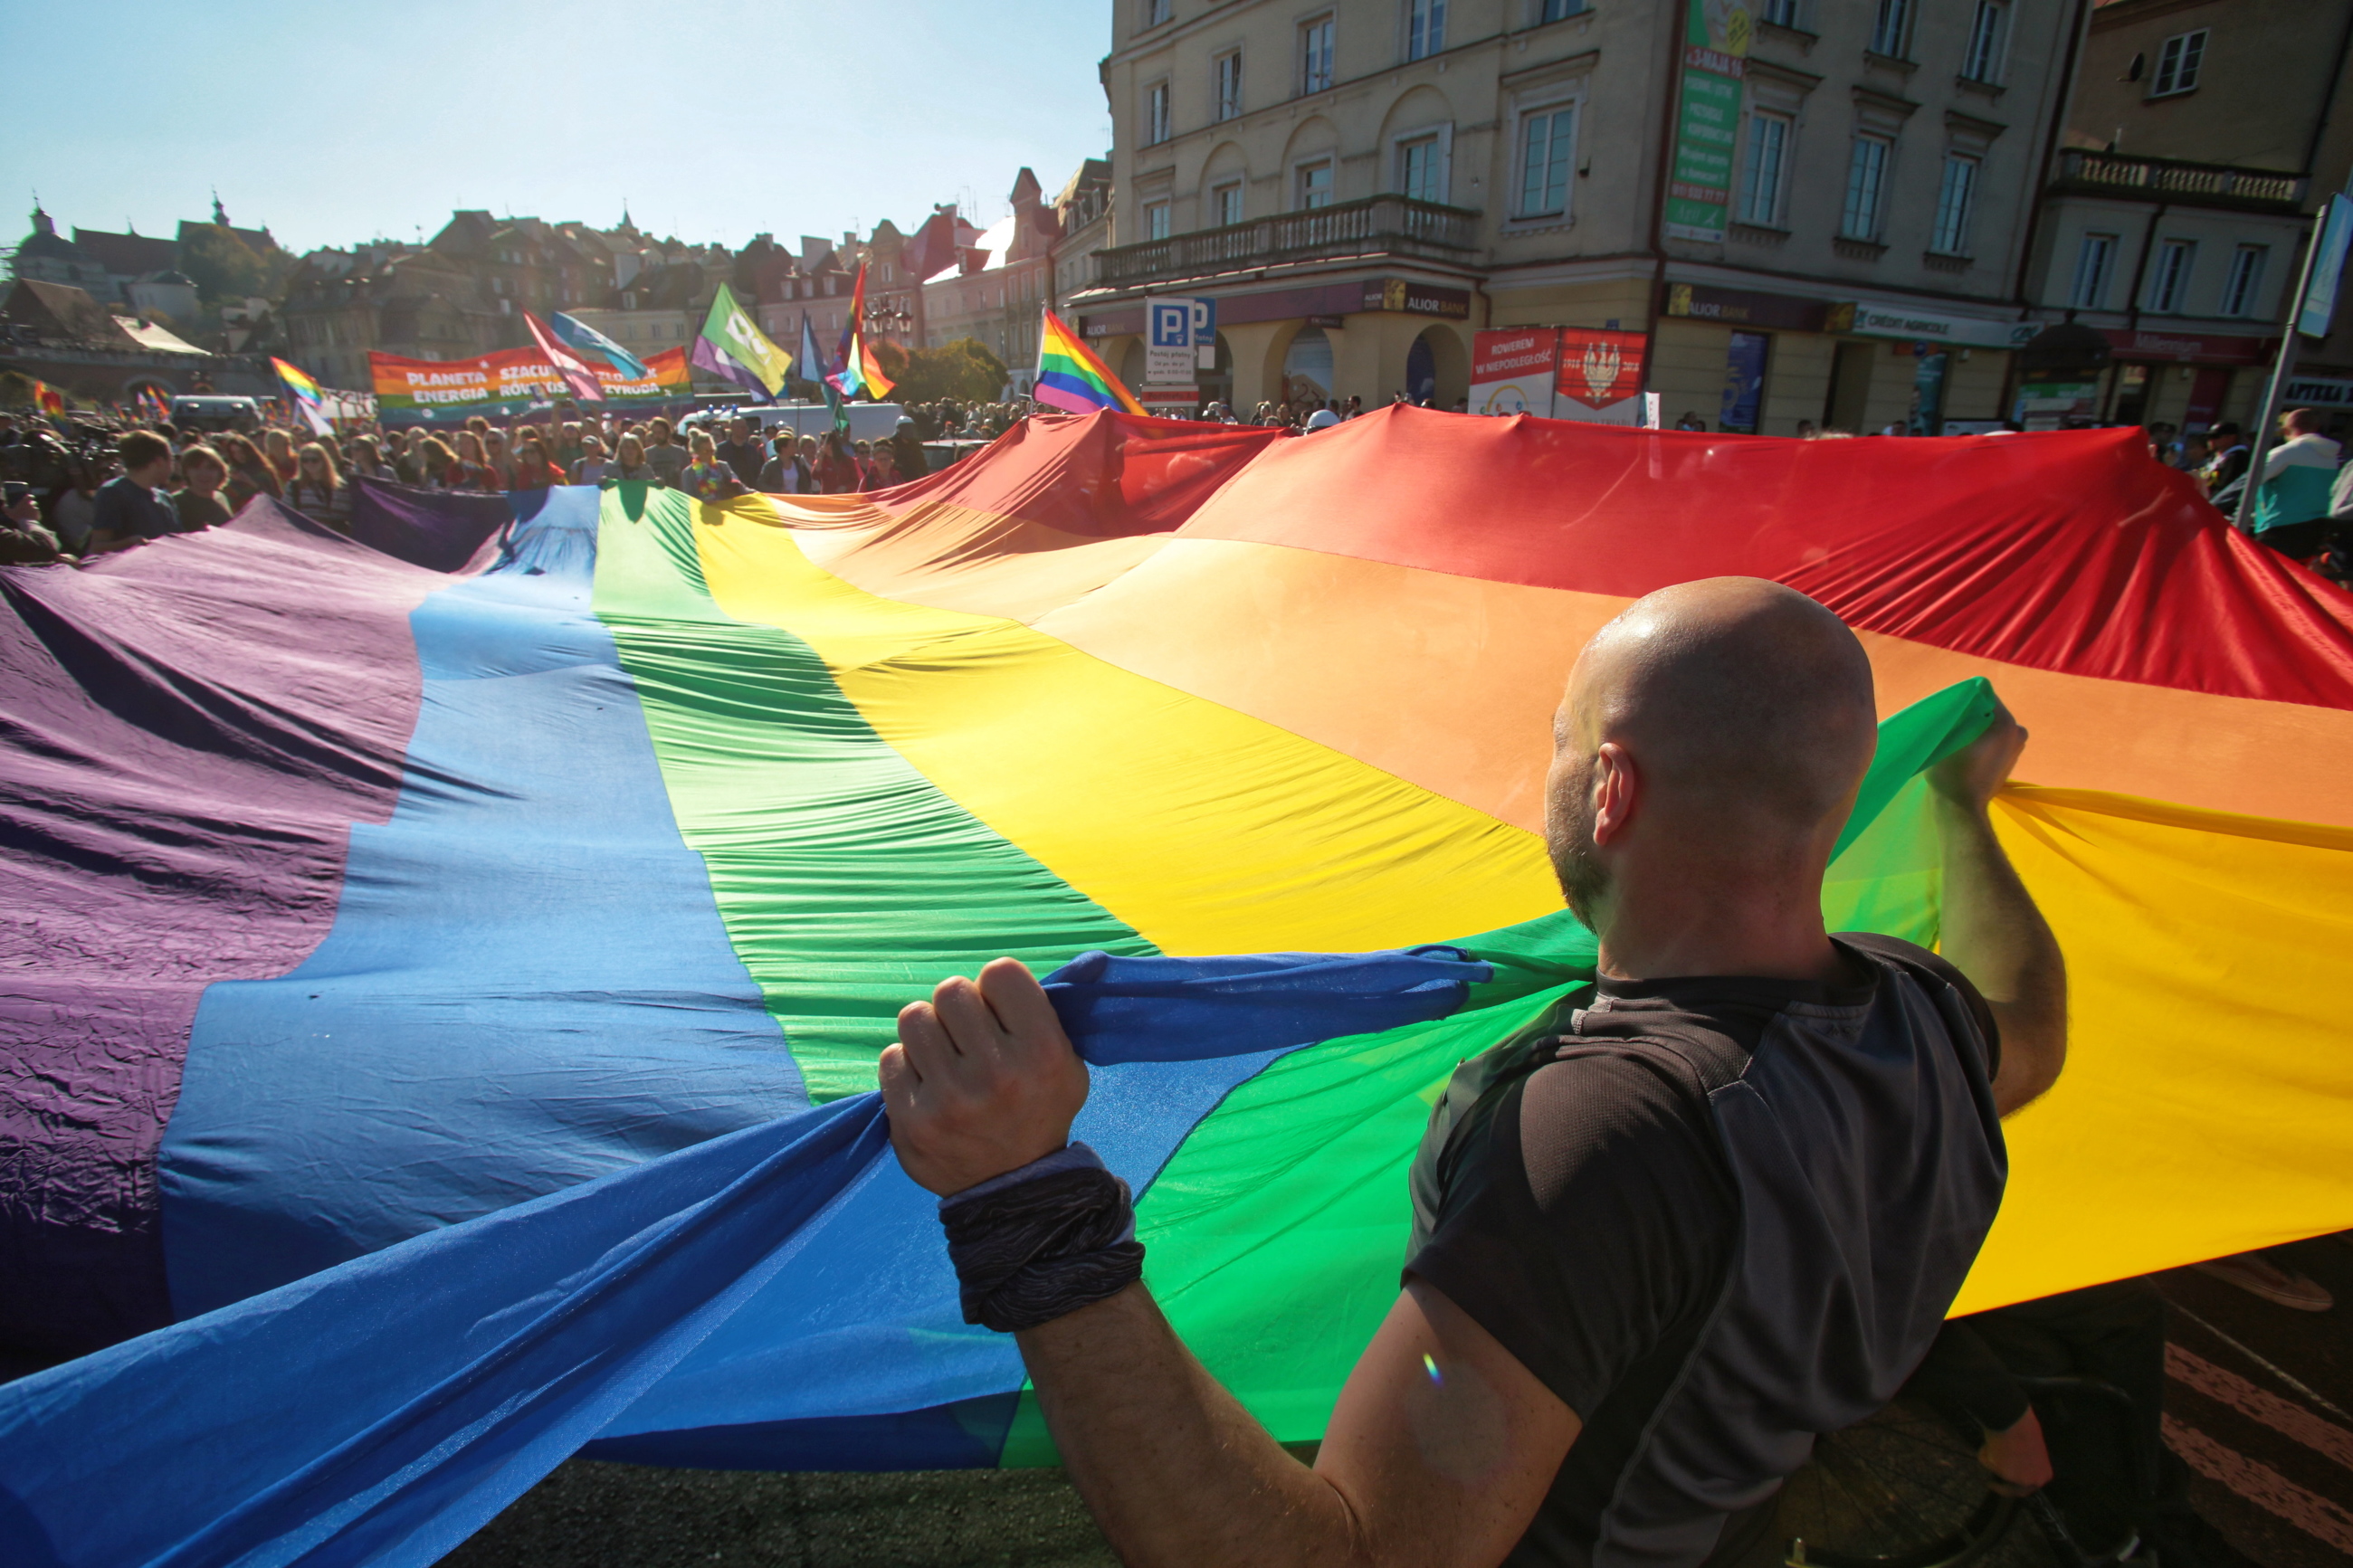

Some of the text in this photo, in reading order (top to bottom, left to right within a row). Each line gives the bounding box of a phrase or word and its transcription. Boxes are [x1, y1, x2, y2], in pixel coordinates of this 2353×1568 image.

[1407, 297, 1466, 314] ALIOR BANK
[1689, 301, 1749, 320] ALIOR BANK
[1086, 325, 1107, 336] ALIOR
[1161, 309, 1183, 343] P
[1491, 337, 1535, 356] ROWEREM
[2133, 334, 2202, 354] Millennium
[1149, 350, 1190, 360] Postój płatny
[1476, 347, 1552, 375] W NIEPODLEGŁOŚĆ
[1563, 358, 1581, 369] 1918
[405, 371, 488, 387] PLANETA
[412, 386, 490, 404] ENERGIA
[603, 382, 662, 395] ZYRODA
[2286, 383, 2343, 403] APTEKA
